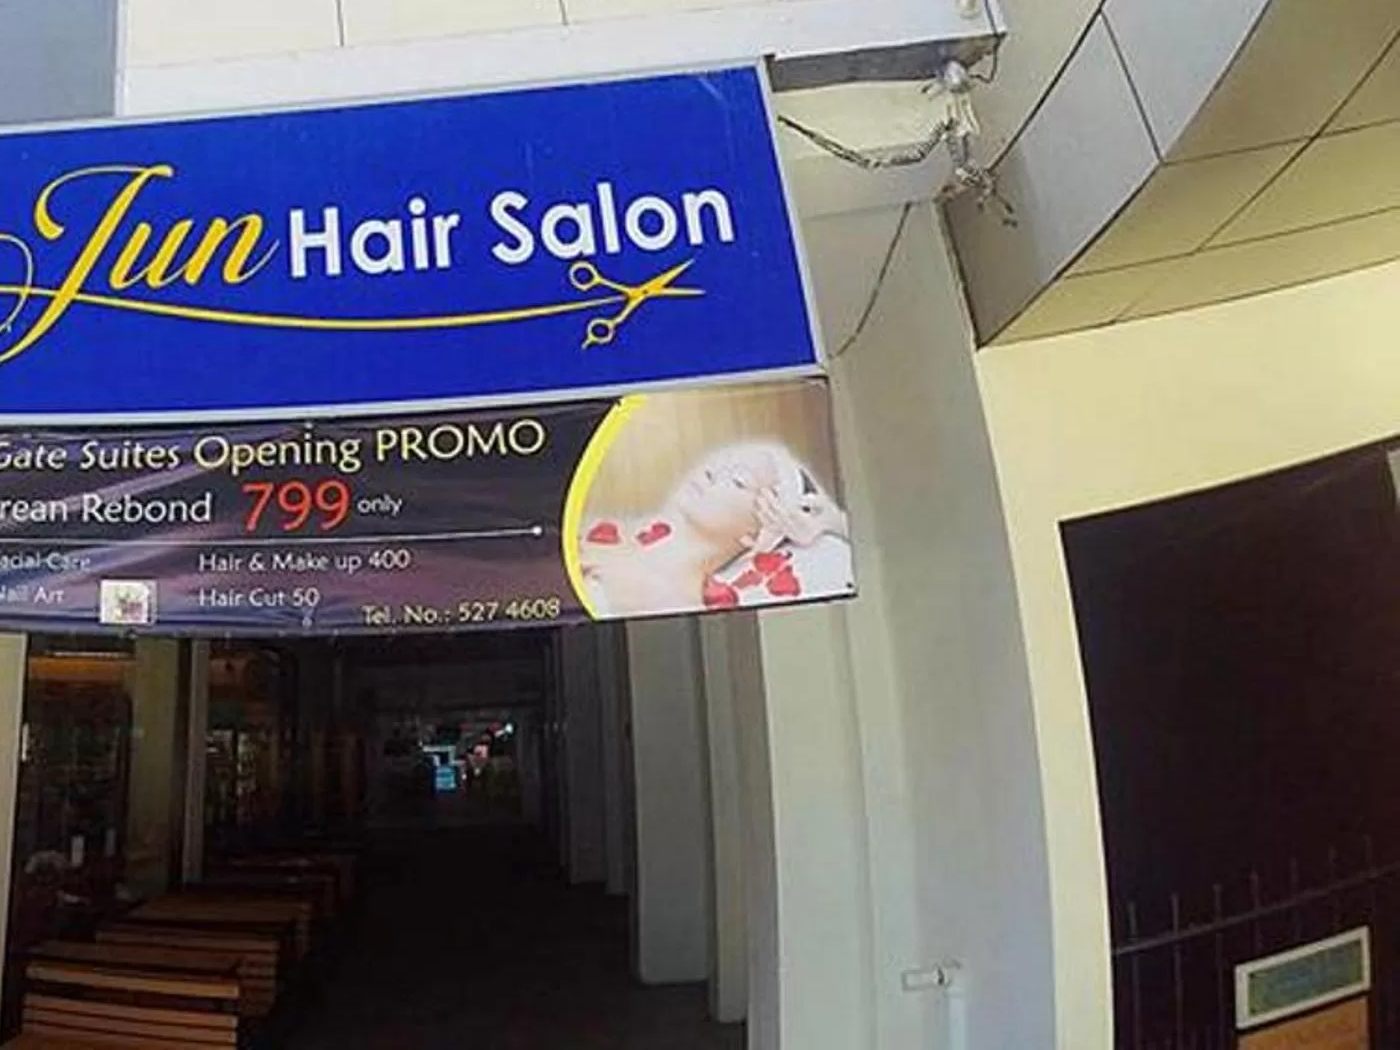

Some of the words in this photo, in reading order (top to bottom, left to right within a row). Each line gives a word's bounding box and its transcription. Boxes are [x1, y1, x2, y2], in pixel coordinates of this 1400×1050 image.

[289, 197, 460, 279] Hair
[490, 181, 735, 265] Salon
[80, 440, 179, 470] Suites
[194, 421, 363, 476] Opening
[376, 419, 546, 463] PROMO
[82, 491, 212, 523] Rebond
[241, 477, 352, 532] 799
[357, 497, 402, 516] only
[199, 553, 242, 572] Hair
[249, 555, 267, 572] &
[272, 552, 328, 572] Make
[335, 555, 363, 574] up
[368, 549, 411, 570] 400
[33, 585, 65, 604] Art
[199, 588, 242, 607] Hair
[249, 588, 285, 608] Cut
[291, 587, 321, 607] 50
[361, 605, 398, 625] Tel.
[457, 601, 499, 622] 527
[505, 599, 561, 620] 4608
